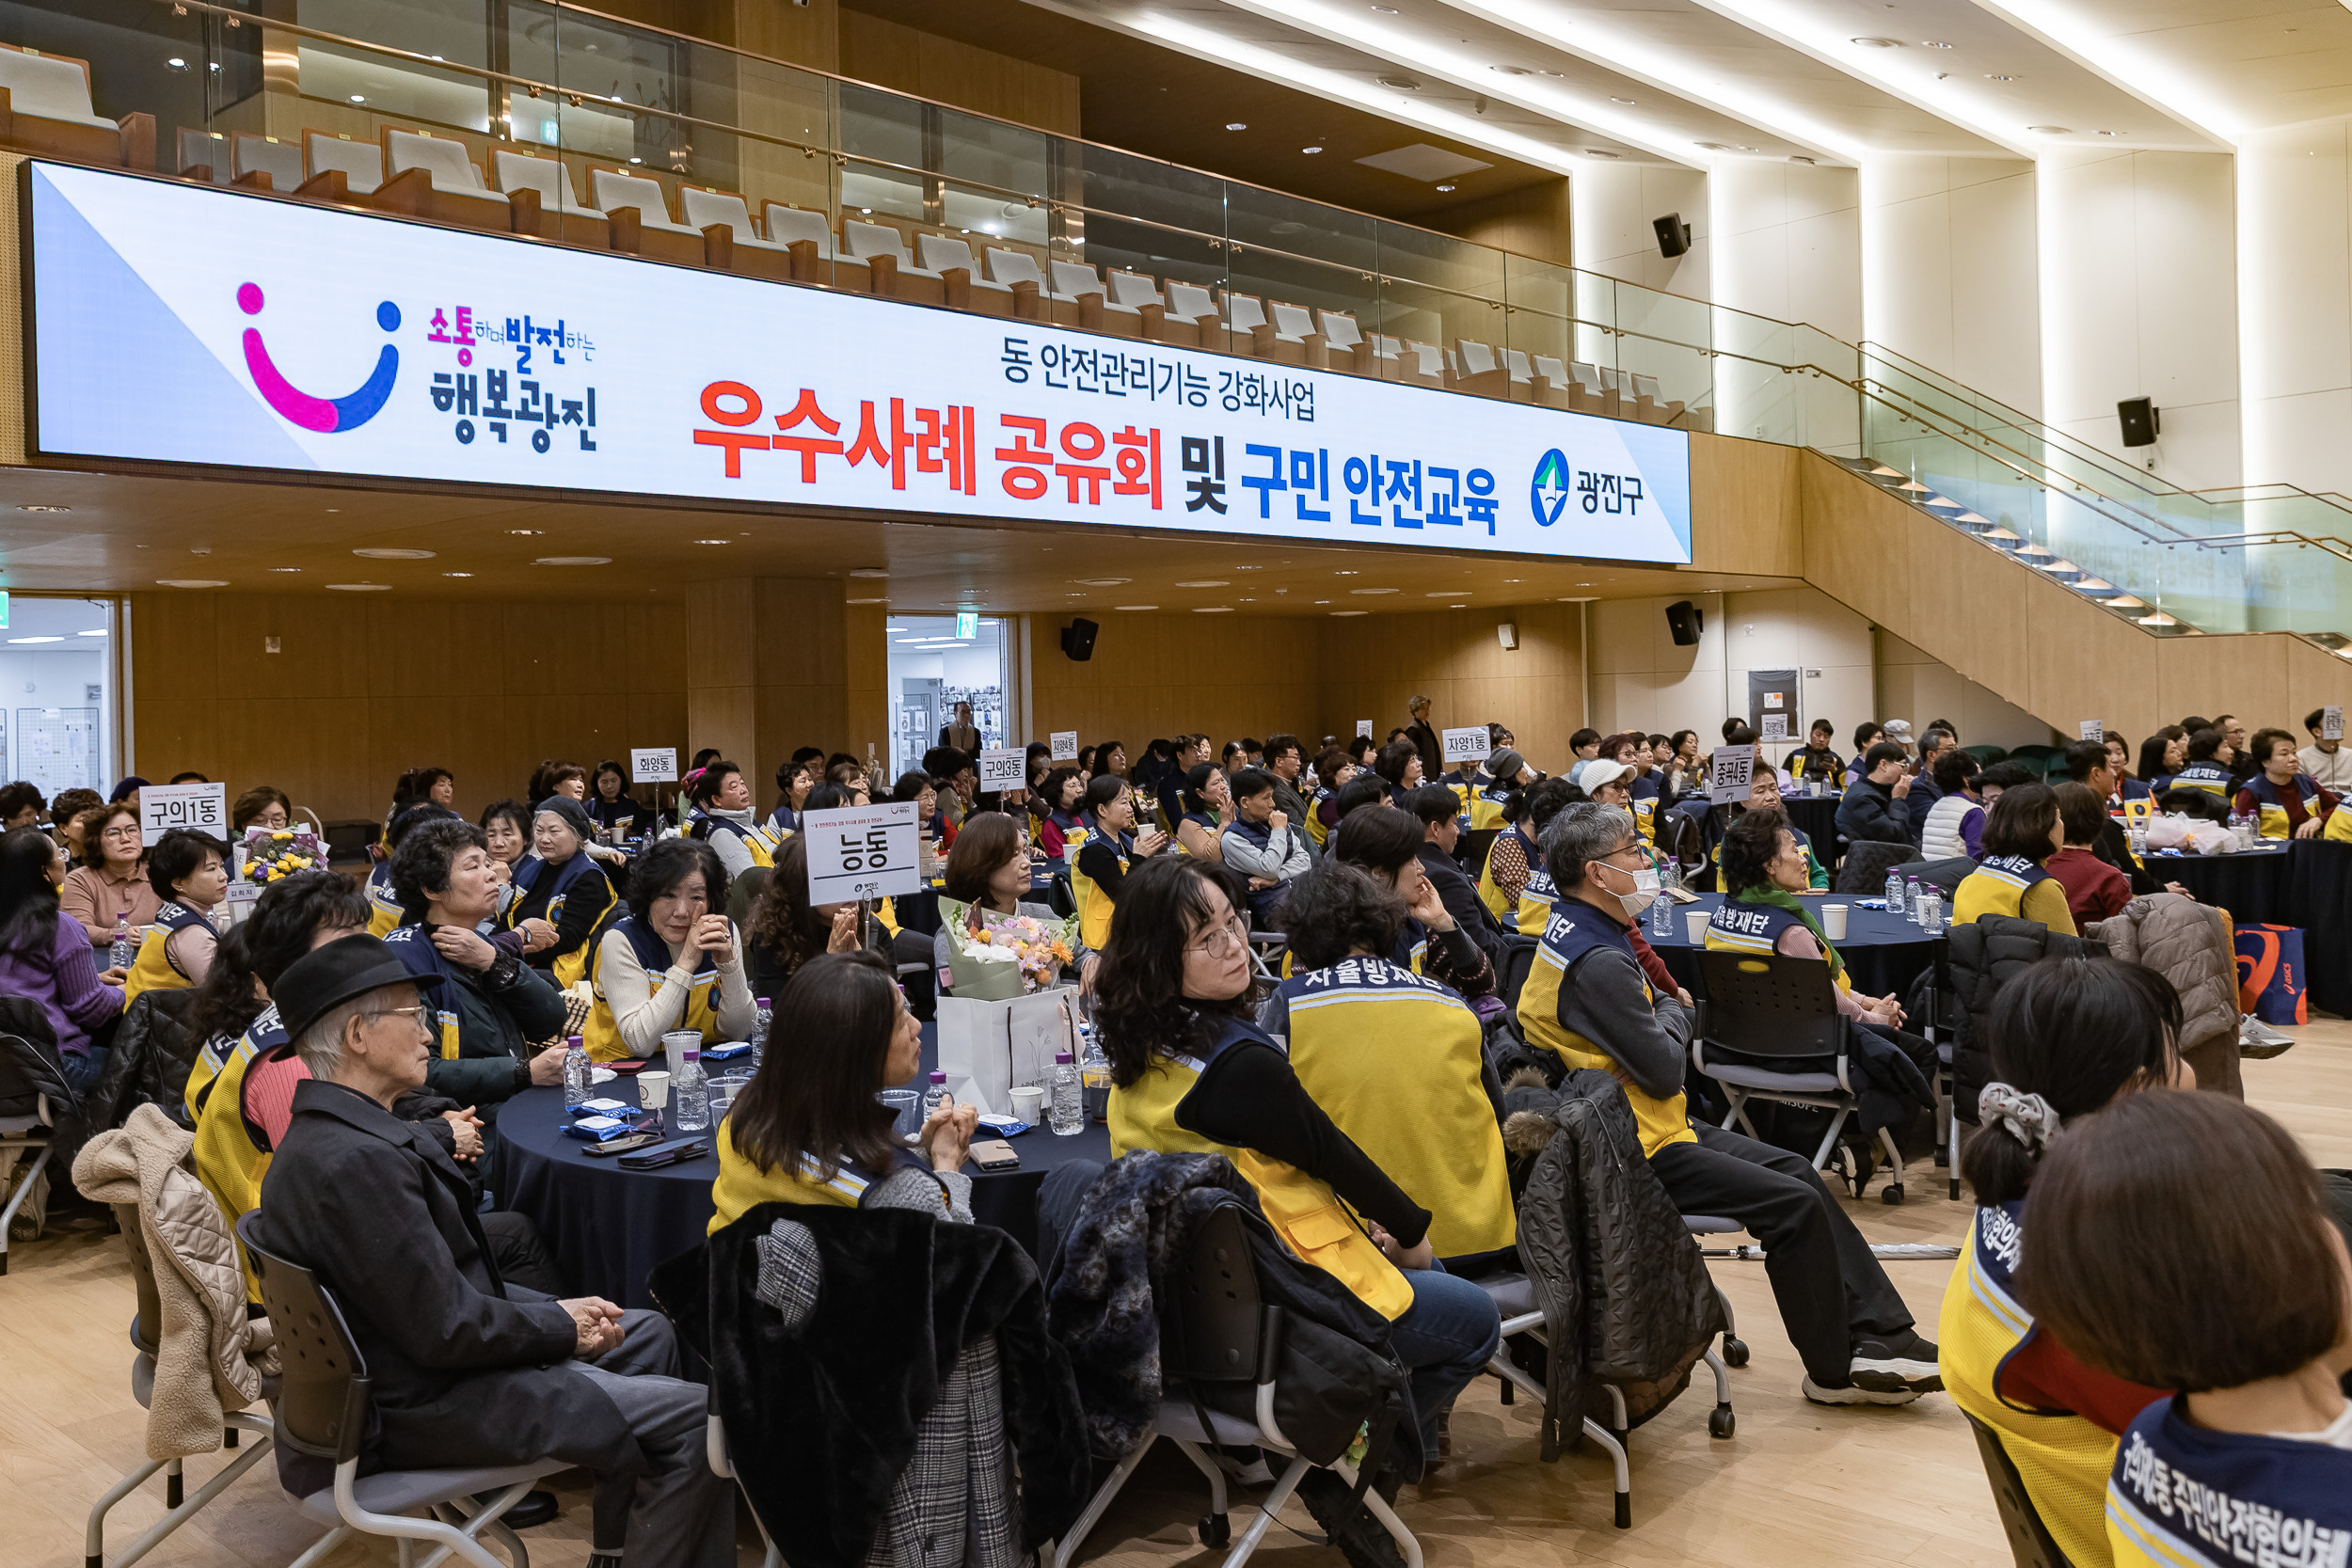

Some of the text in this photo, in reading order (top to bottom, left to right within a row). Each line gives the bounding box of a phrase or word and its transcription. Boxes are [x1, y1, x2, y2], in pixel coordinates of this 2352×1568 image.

[1000, 337, 1314, 423] 동 안전관리기능 강화사업
[429, 368, 597, 454] 행복광진
[692, 380, 1500, 536] 우수사례 공유회 및 구민 안전교육
[1574, 470, 1644, 516] 광진구
[1447, 736, 1486, 752] 자양1동
[640, 757, 670, 771] 화양동
[985, 759, 1022, 779] 구의3동
[1717, 761, 1749, 786] 중곡4동
[150, 800, 217, 826] 구의1동
[840, 830, 889, 872] 능동
